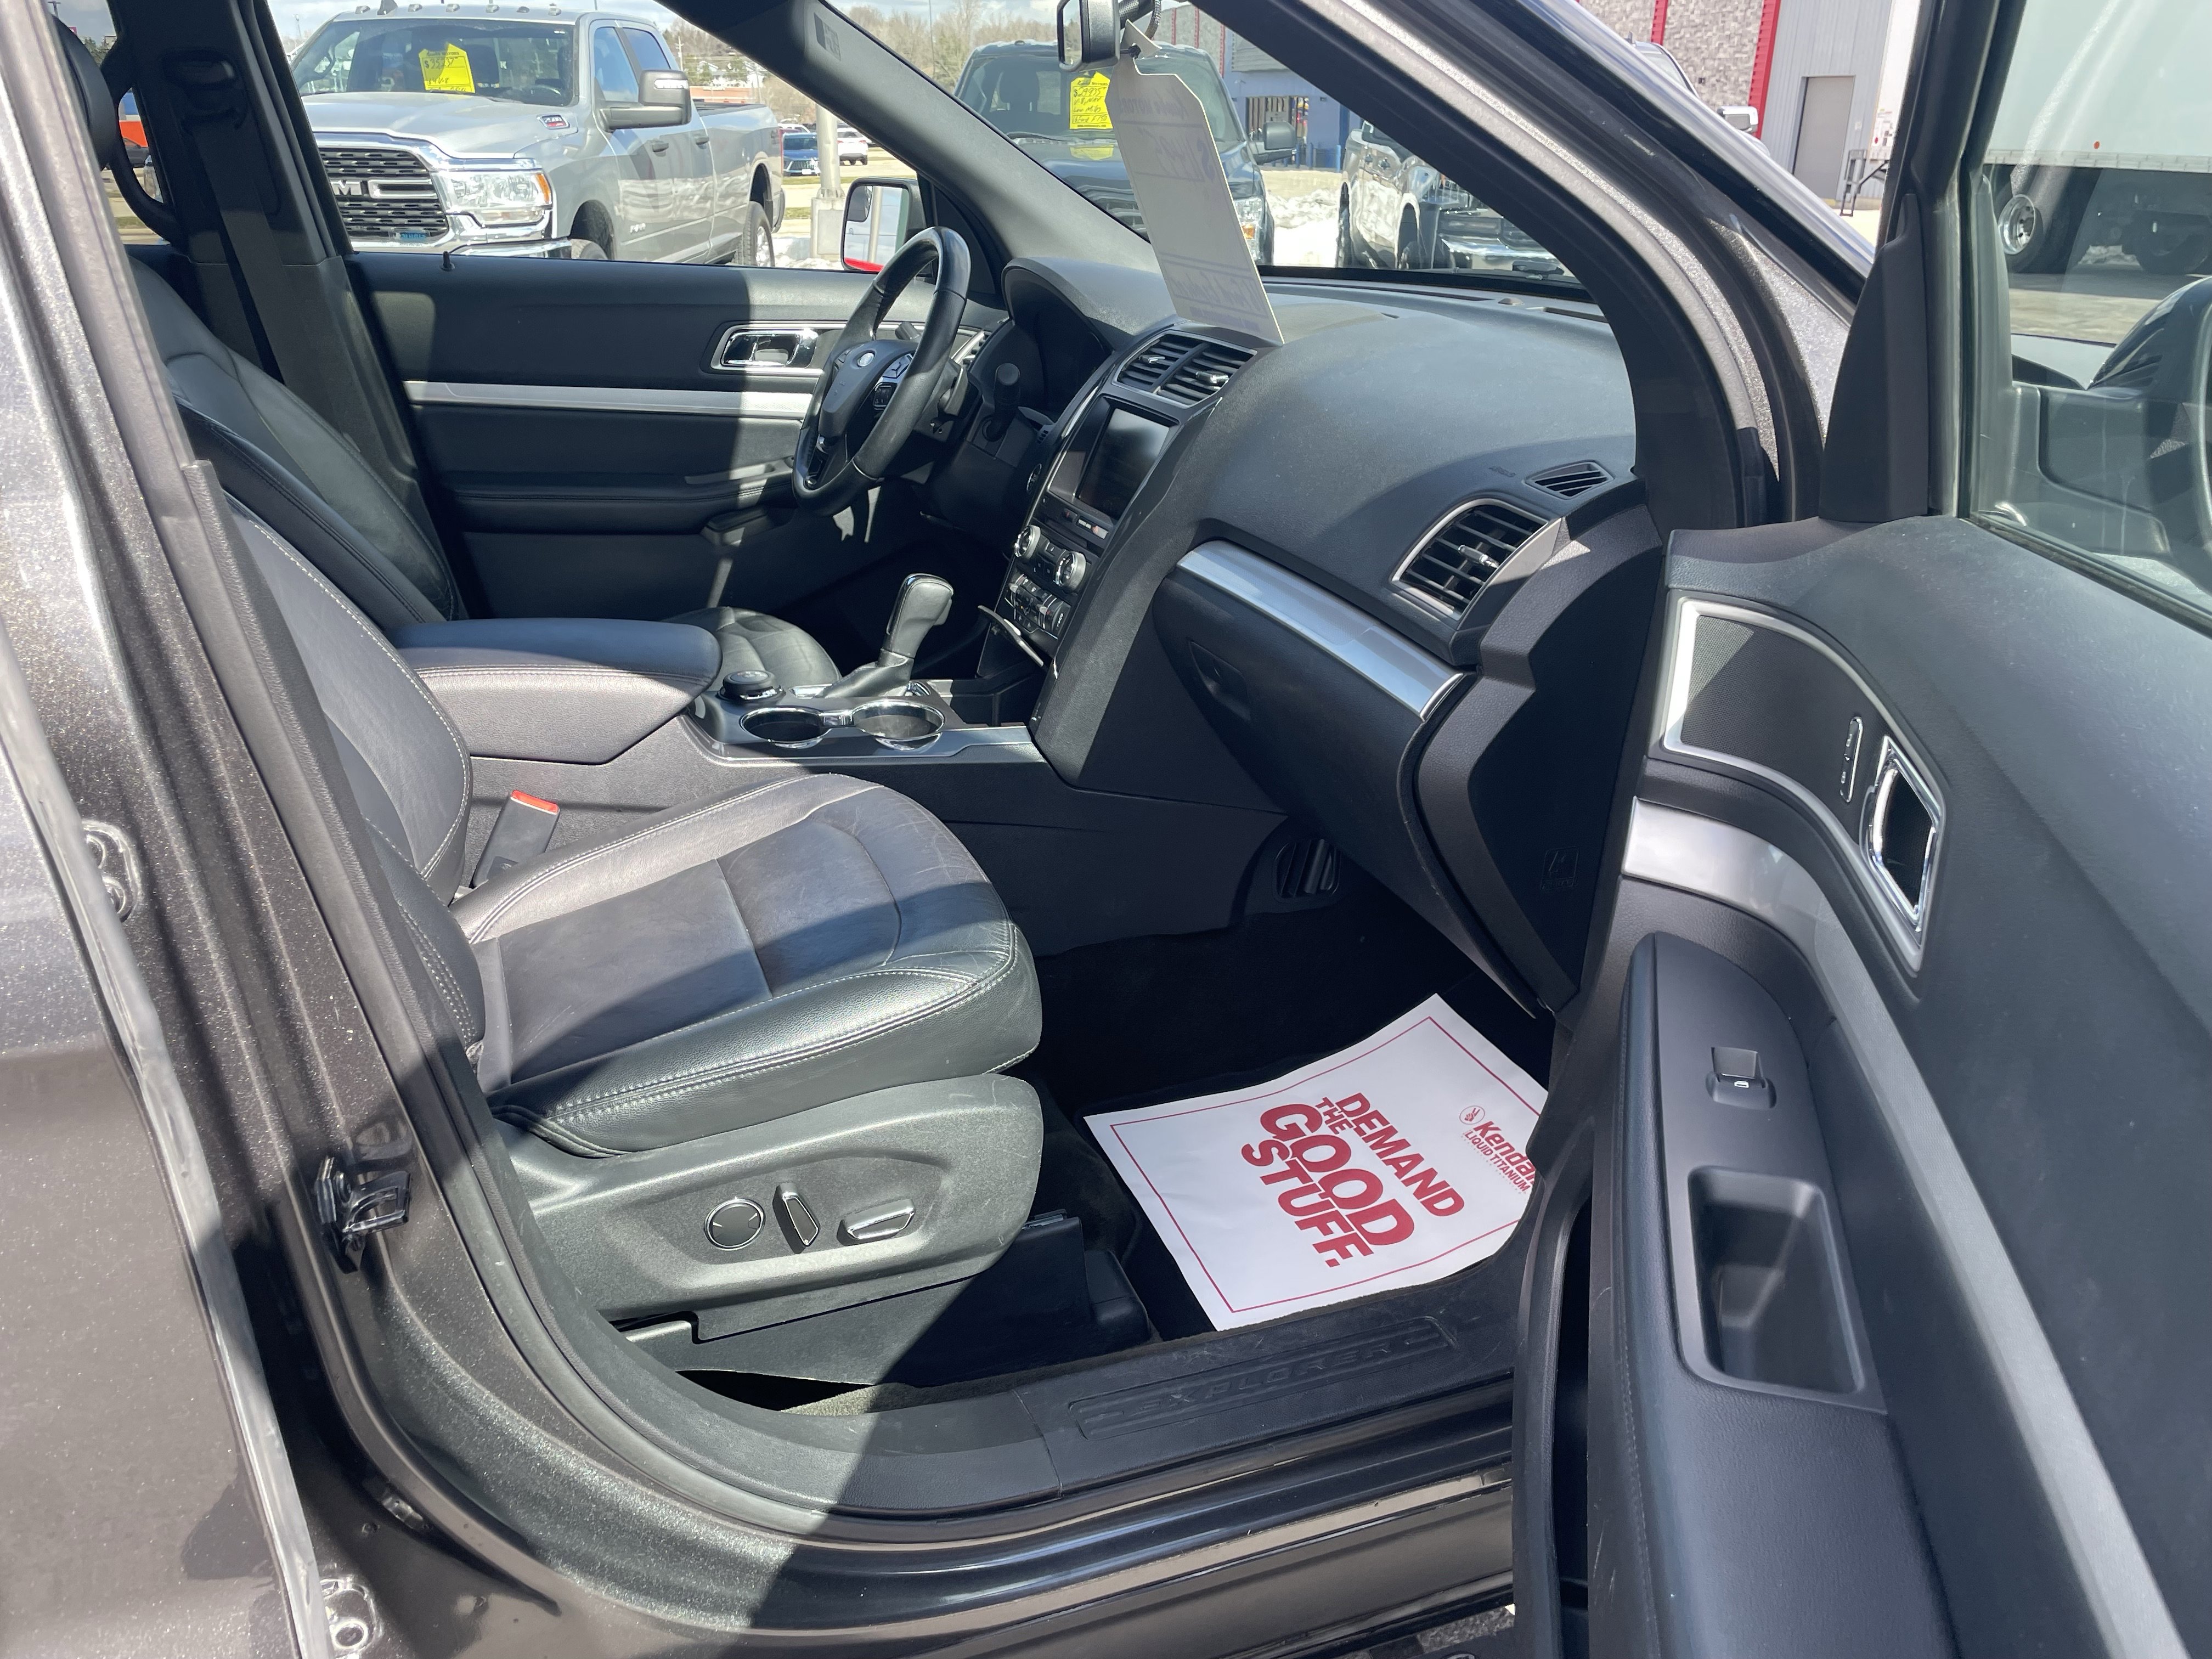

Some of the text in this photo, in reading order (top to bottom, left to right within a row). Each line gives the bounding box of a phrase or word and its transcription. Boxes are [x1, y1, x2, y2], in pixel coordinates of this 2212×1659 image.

[1315, 1097, 1354, 1135] THE
[1335, 1092, 1465, 1217] DEMAND
[1464, 1131, 1531, 1192] LIQUID TITANIUM
[1474, 1121, 1536, 1185] Kenda
[1241, 1139, 1374, 1267] STUFF.
[1260, 1104, 1414, 1245] GOOD
